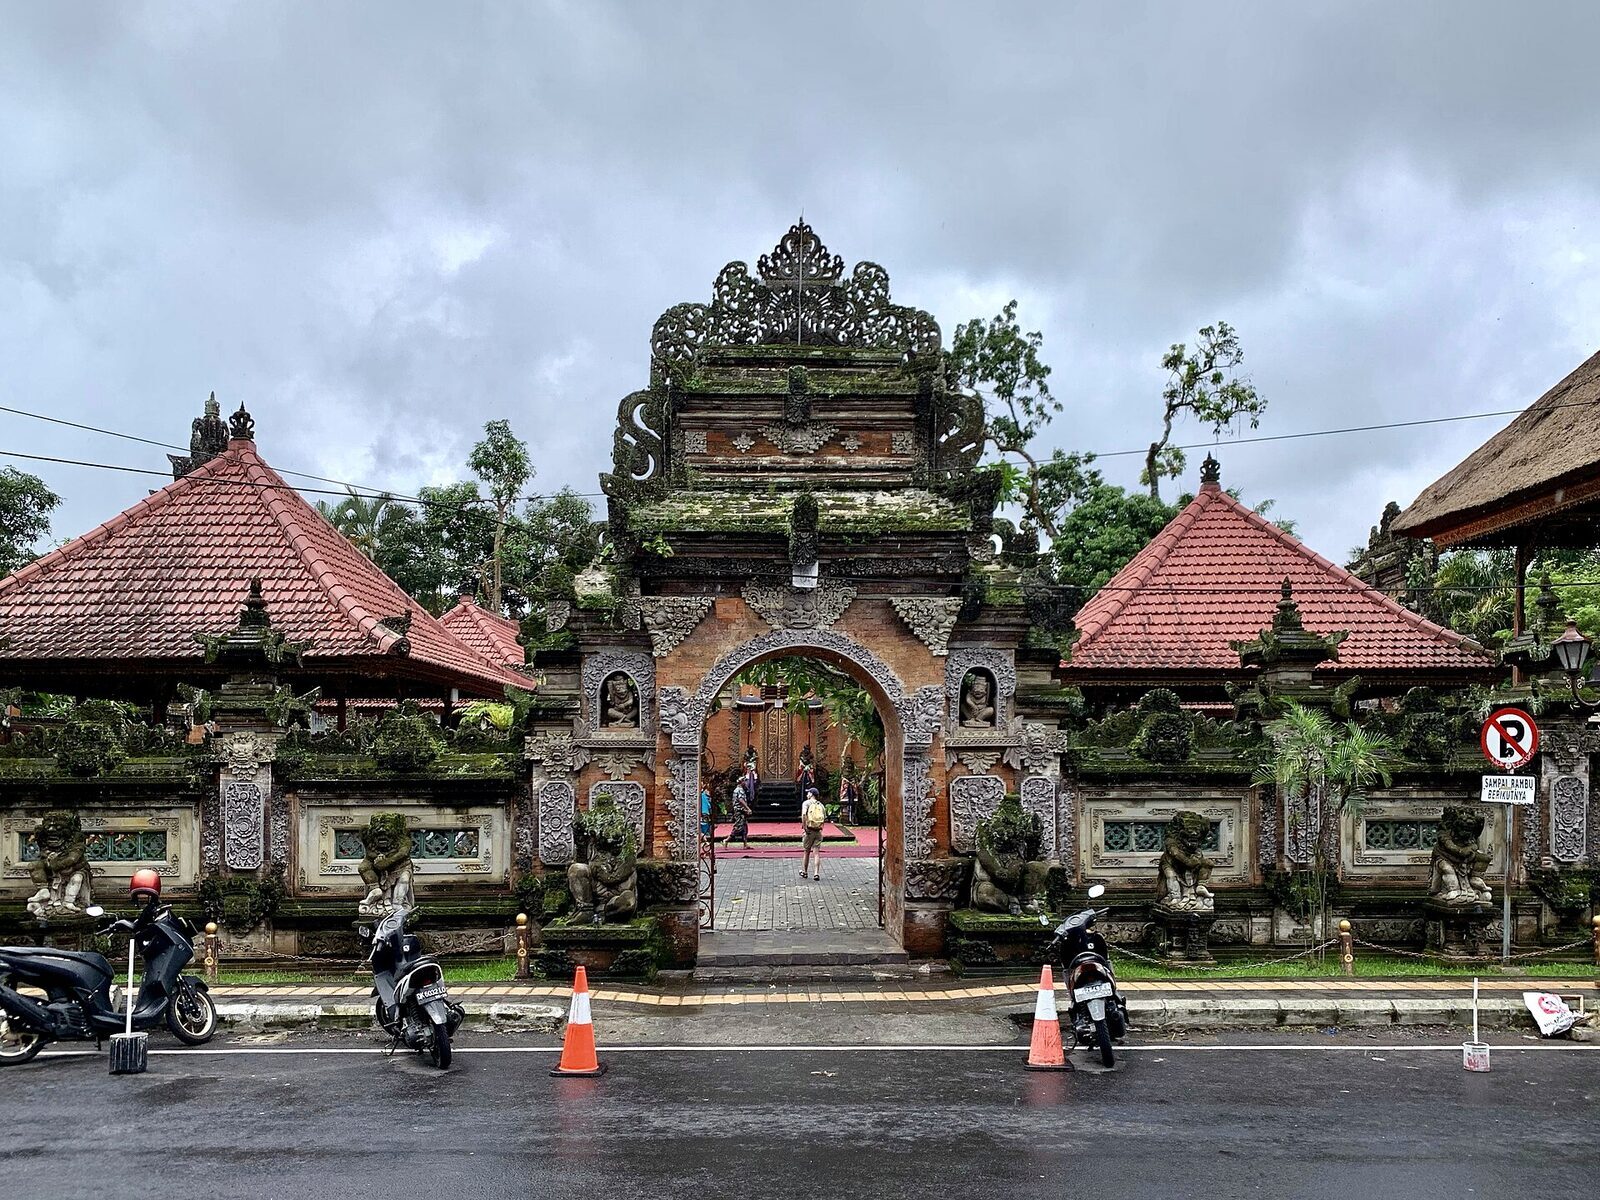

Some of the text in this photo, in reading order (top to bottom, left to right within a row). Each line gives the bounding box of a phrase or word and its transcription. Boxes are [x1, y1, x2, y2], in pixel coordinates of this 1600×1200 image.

[1500, 720, 1525, 758] P
[1484, 778, 1533, 789] SAMPAI RAMBU
[1488, 789, 1527, 801] BERIKUTNYA
